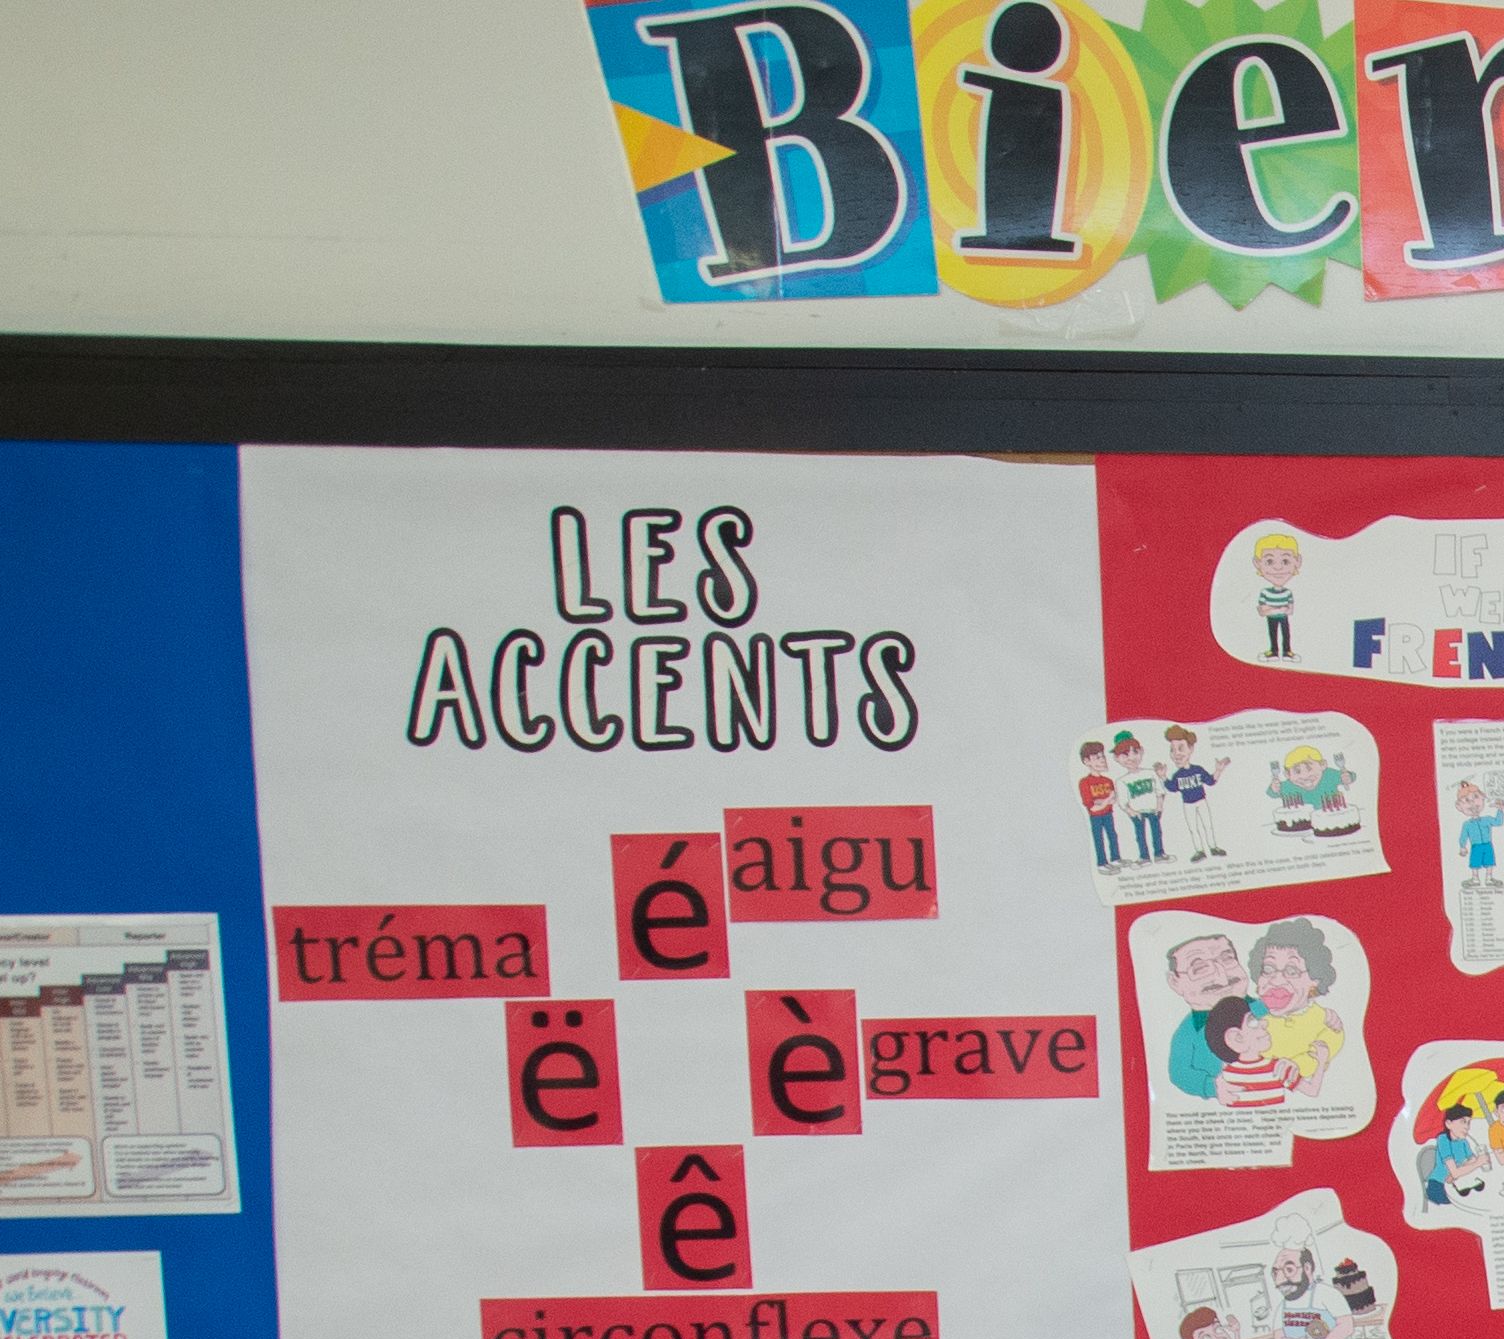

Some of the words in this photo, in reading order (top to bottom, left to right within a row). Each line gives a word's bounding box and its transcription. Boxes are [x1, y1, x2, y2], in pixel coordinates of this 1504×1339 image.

[549, 506, 758, 625] LES
[1432, 532, 1488, 578] IF
[406, 627, 919, 751] ACCENTS
[631, 840, 713, 973] é
[730, 813, 934, 915] aigu
[288, 911, 538, 987] tréma
[520, 1008, 602, 1132] ë
[767, 996, 849, 1121] è
[866, 1021, 1089, 1096] grave
[658, 1152, 740, 1283] ê
